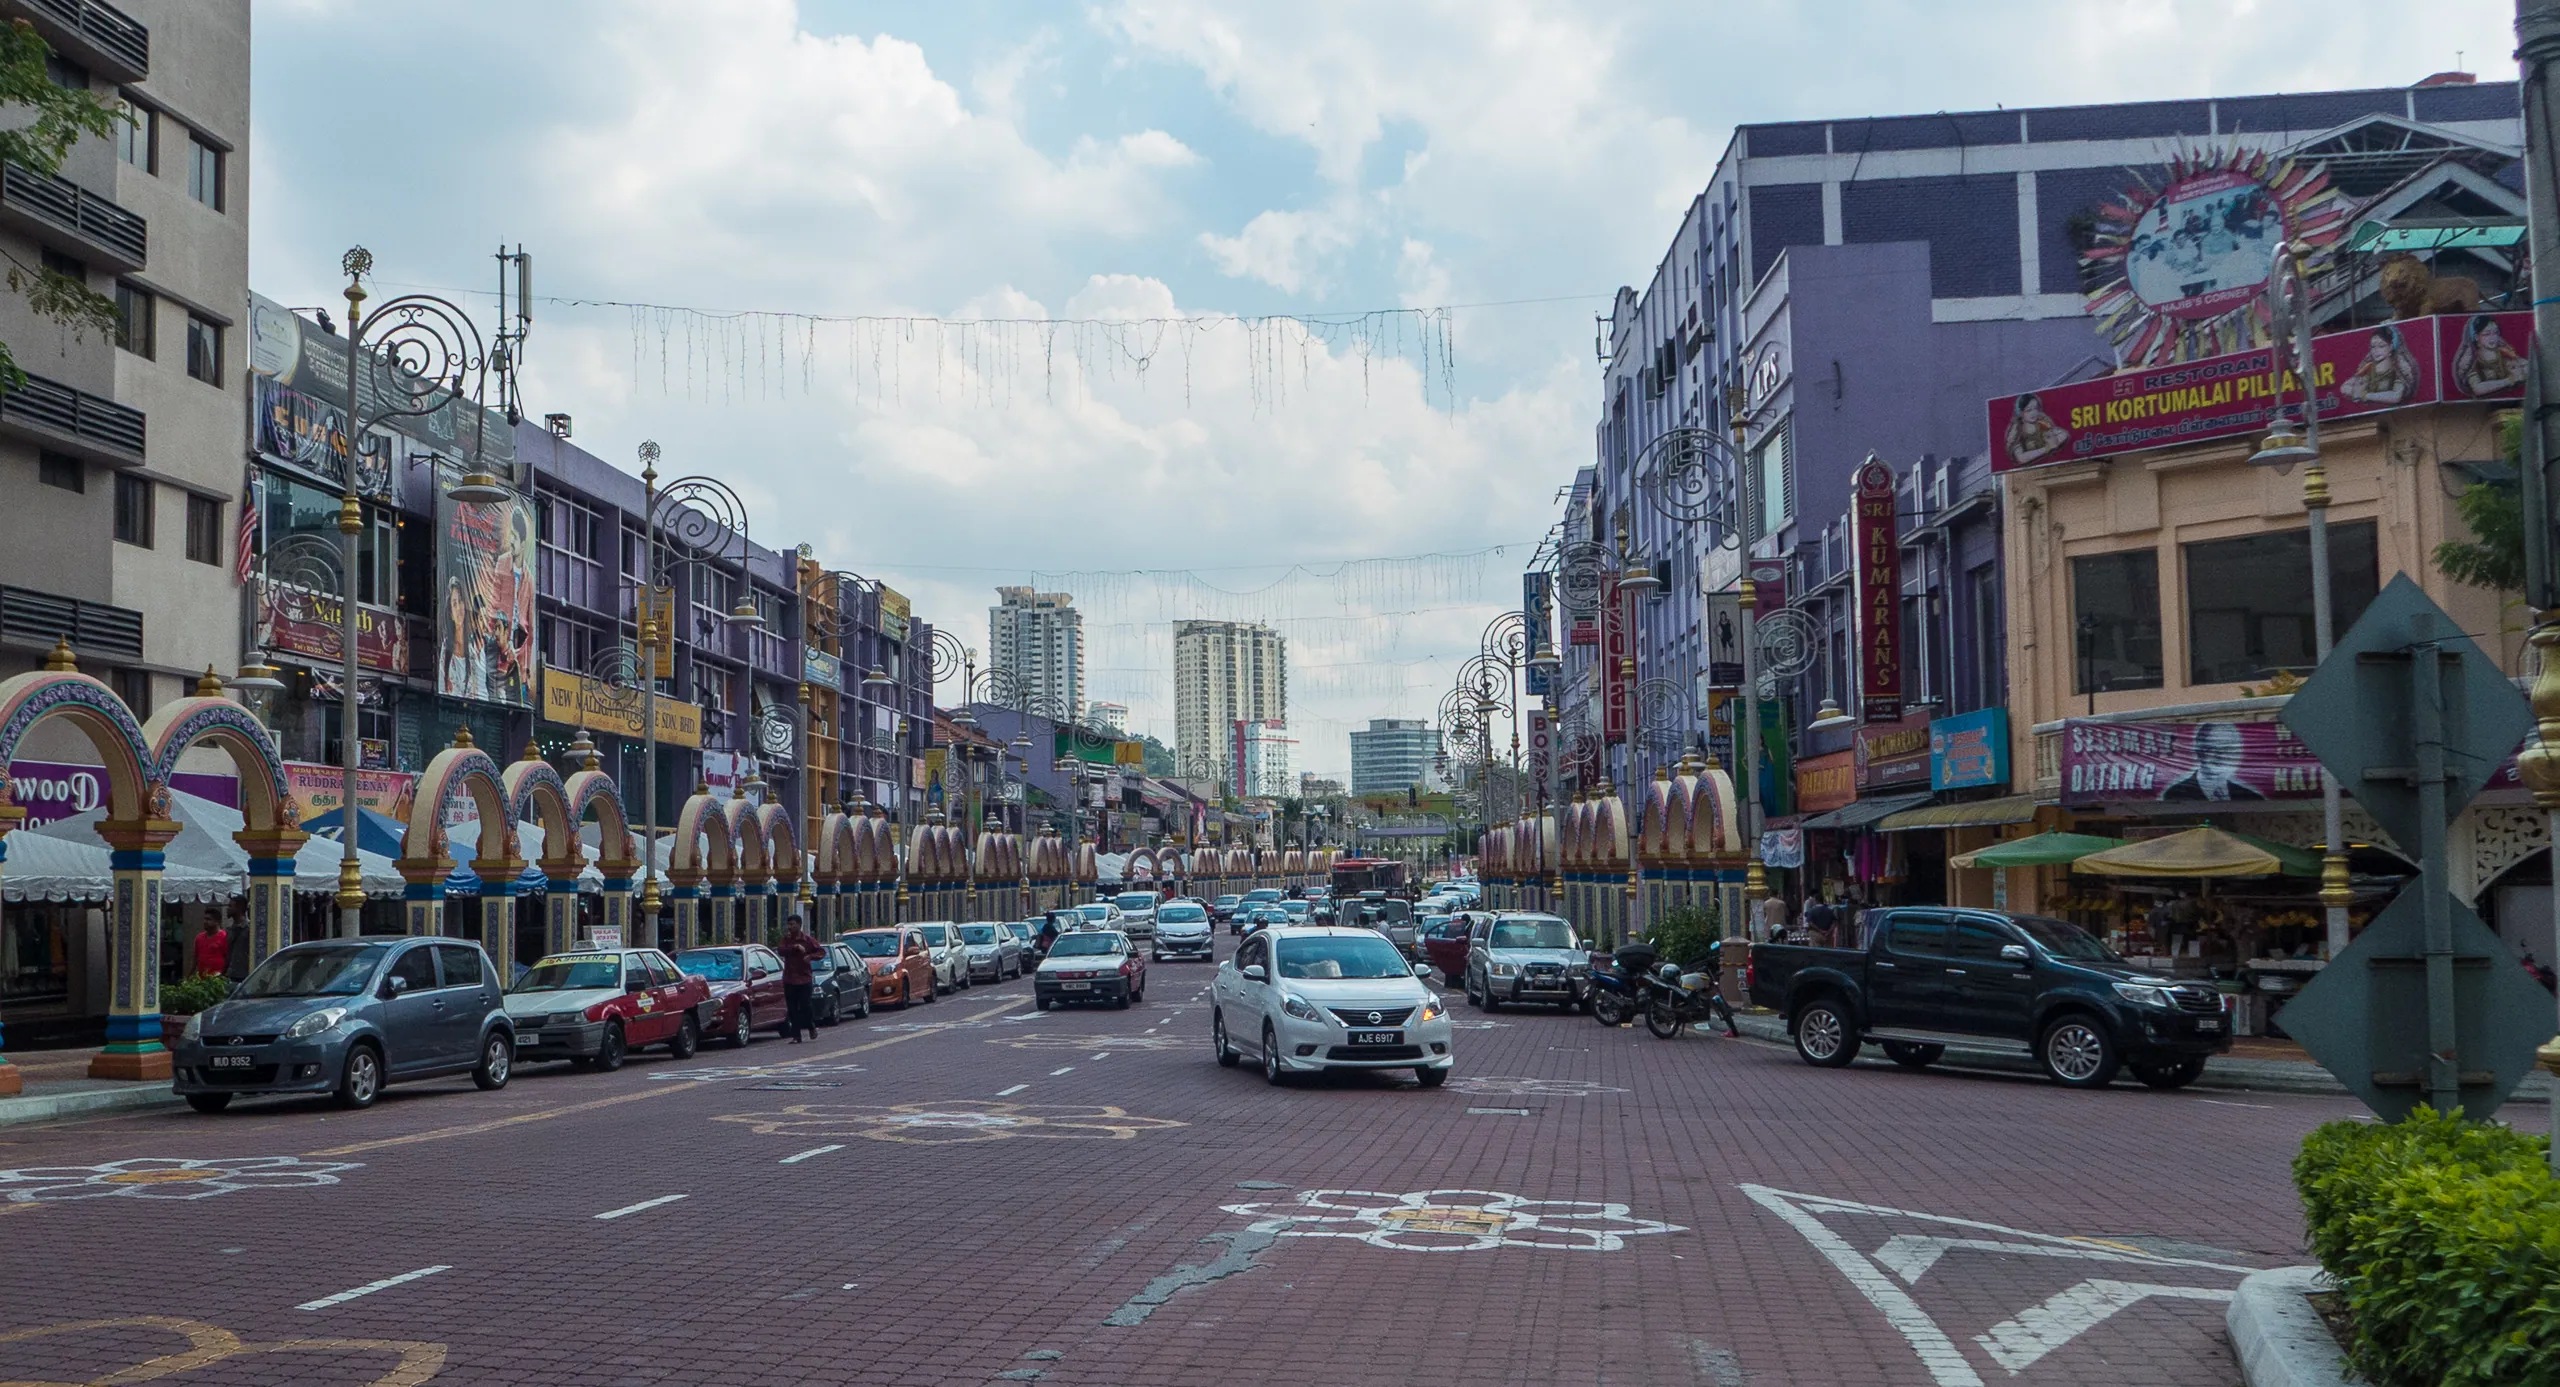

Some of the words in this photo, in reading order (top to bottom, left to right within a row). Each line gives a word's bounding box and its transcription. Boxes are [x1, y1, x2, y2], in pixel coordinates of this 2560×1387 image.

[2161, 294, 2203, 312] NAJIB'S
[2205, 287, 2250, 305] CORNER
[2144, 355, 2268, 390] RESTORAN
[2071, 404, 2100, 429] SRI
[2106, 381, 2231, 423] KORTUMALAI
[2237, 362, 2336, 400] PILLAAR
[1863, 503, 1893, 516] SRI
[1870, 527, 1898, 686] KUMARAN'S
[551, 686, 573, 707] NEW
[2071, 726, 2175, 757] SELAMAT
[2071, 763, 2156, 792] DATANG
[1358, 1034, 1373, 1043] AJE
[1375, 1034, 1394, 1043] 6917
[231, 1057, 250, 1066] 9352
